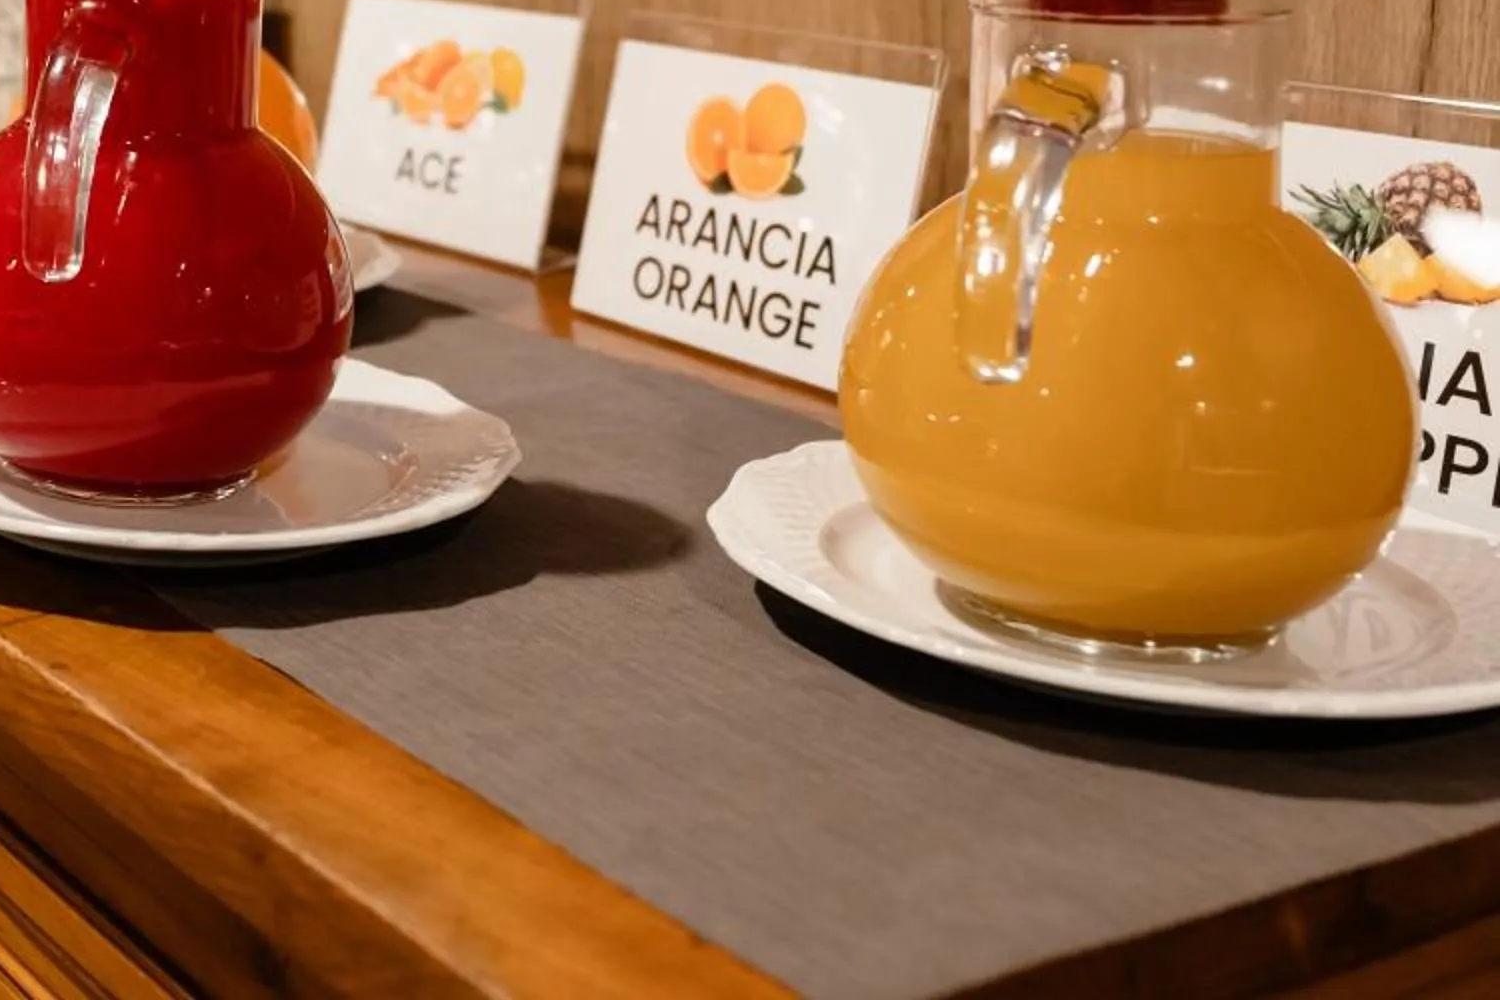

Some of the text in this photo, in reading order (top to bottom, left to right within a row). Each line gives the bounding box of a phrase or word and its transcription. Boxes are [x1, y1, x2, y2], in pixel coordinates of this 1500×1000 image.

[395, 146, 467, 195] ACE
[635, 194, 837, 286] ARANCIA
[632, 256, 822, 351] ORANGE
